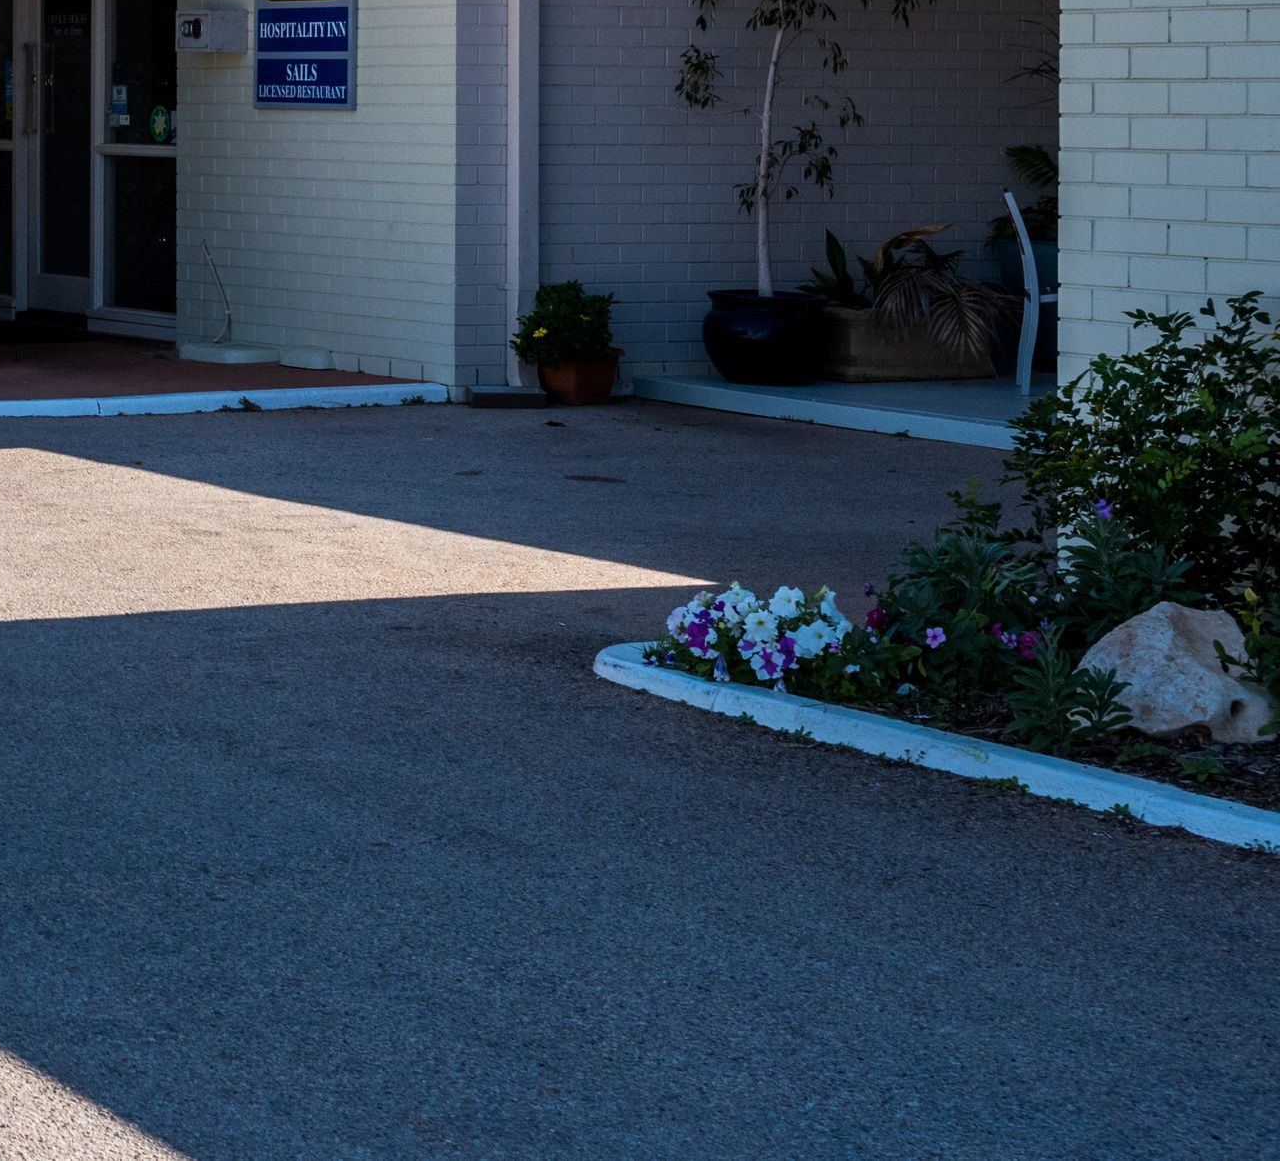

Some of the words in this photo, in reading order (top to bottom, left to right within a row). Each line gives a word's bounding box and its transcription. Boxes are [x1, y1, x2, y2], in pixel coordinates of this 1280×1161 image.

[260, 22, 325, 38] HOSPITALITY
[327, 21, 346, 37] INN
[286, 64, 317, 81] SAILS
[259, 85, 296, 98] LICENSED
[297, 86, 346, 98] RESTAURANT
